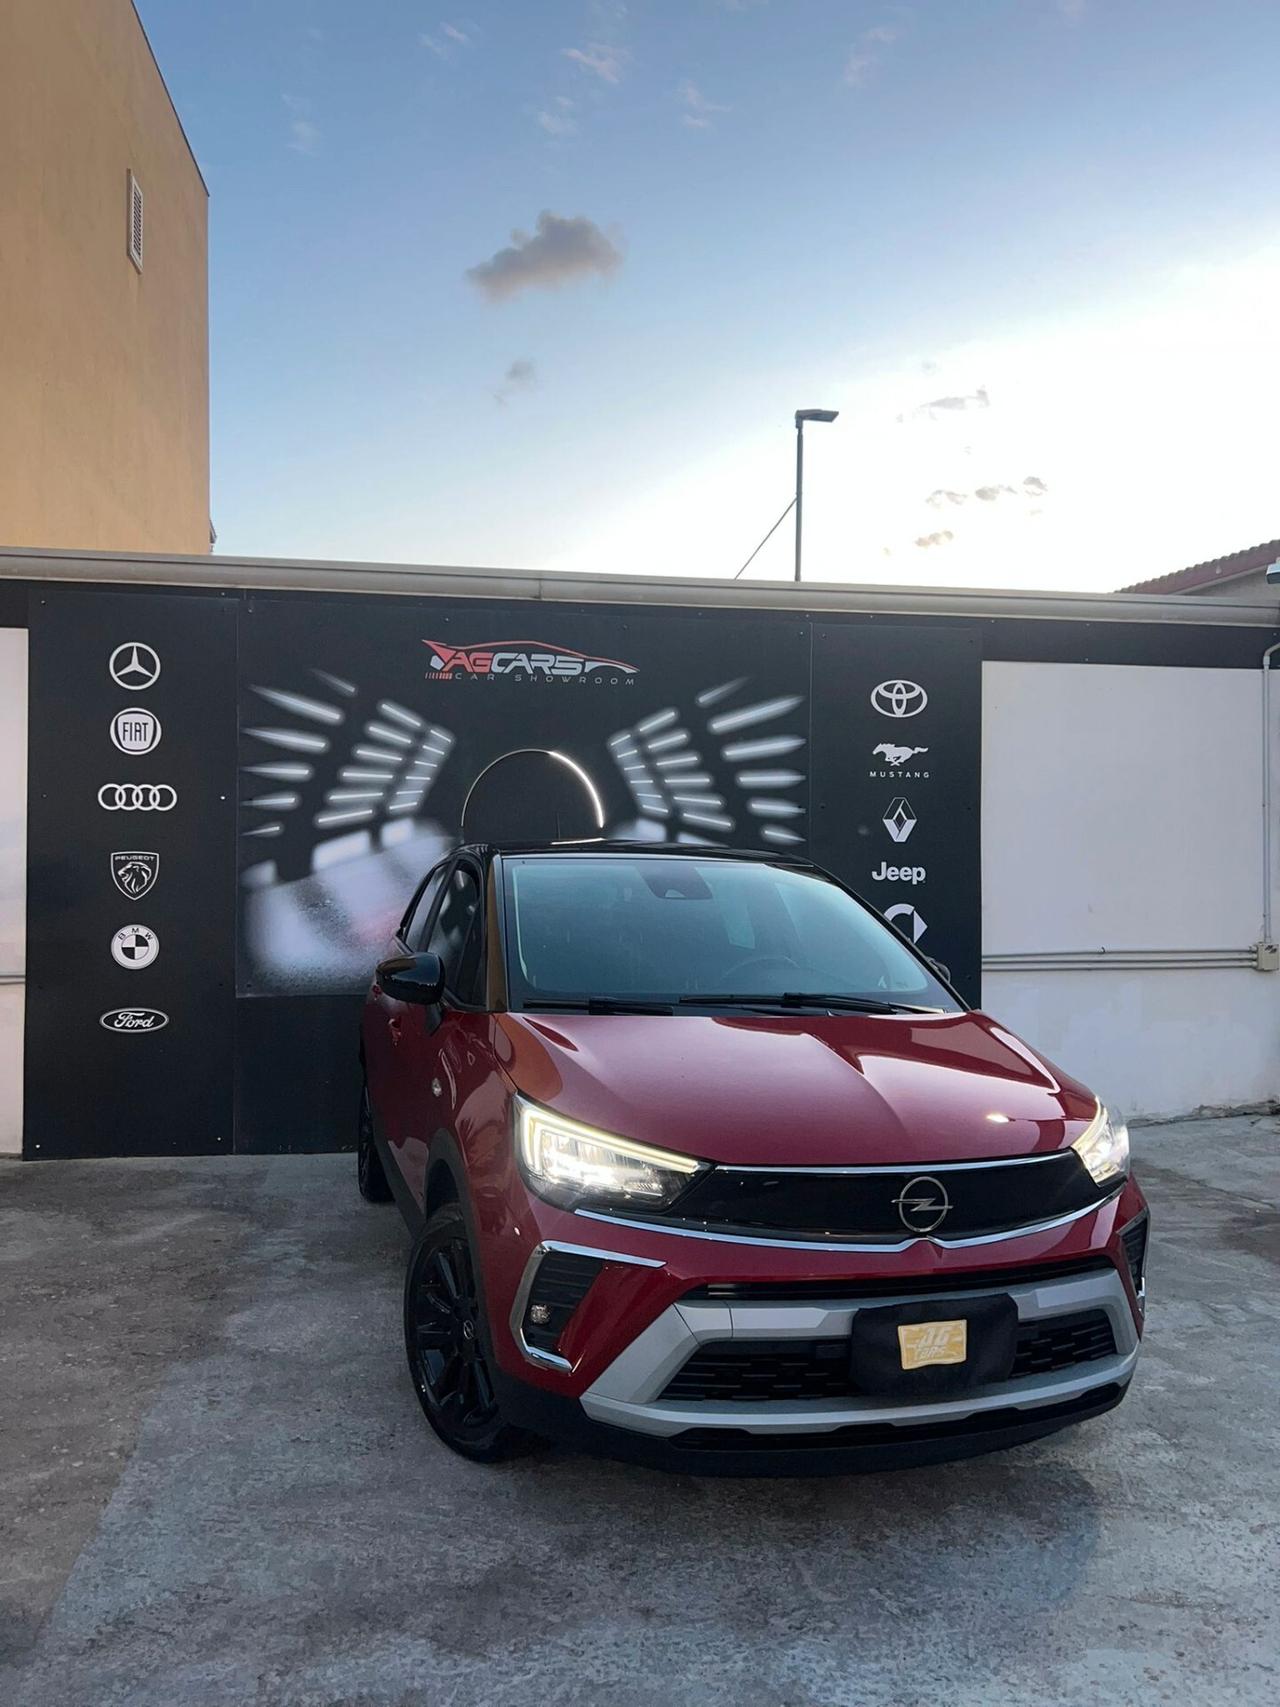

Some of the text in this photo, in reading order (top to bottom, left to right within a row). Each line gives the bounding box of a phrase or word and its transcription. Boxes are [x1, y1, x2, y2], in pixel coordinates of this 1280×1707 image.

[455, 672, 635, 686] CAR SHOWROOM
[122, 721, 149, 742] FIAT
[869, 771, 930, 779] MUSTANG
[871, 861, 927, 885] Jeep
[117, 927, 154, 941] BMW
[113, 1011, 155, 1028] Ford
